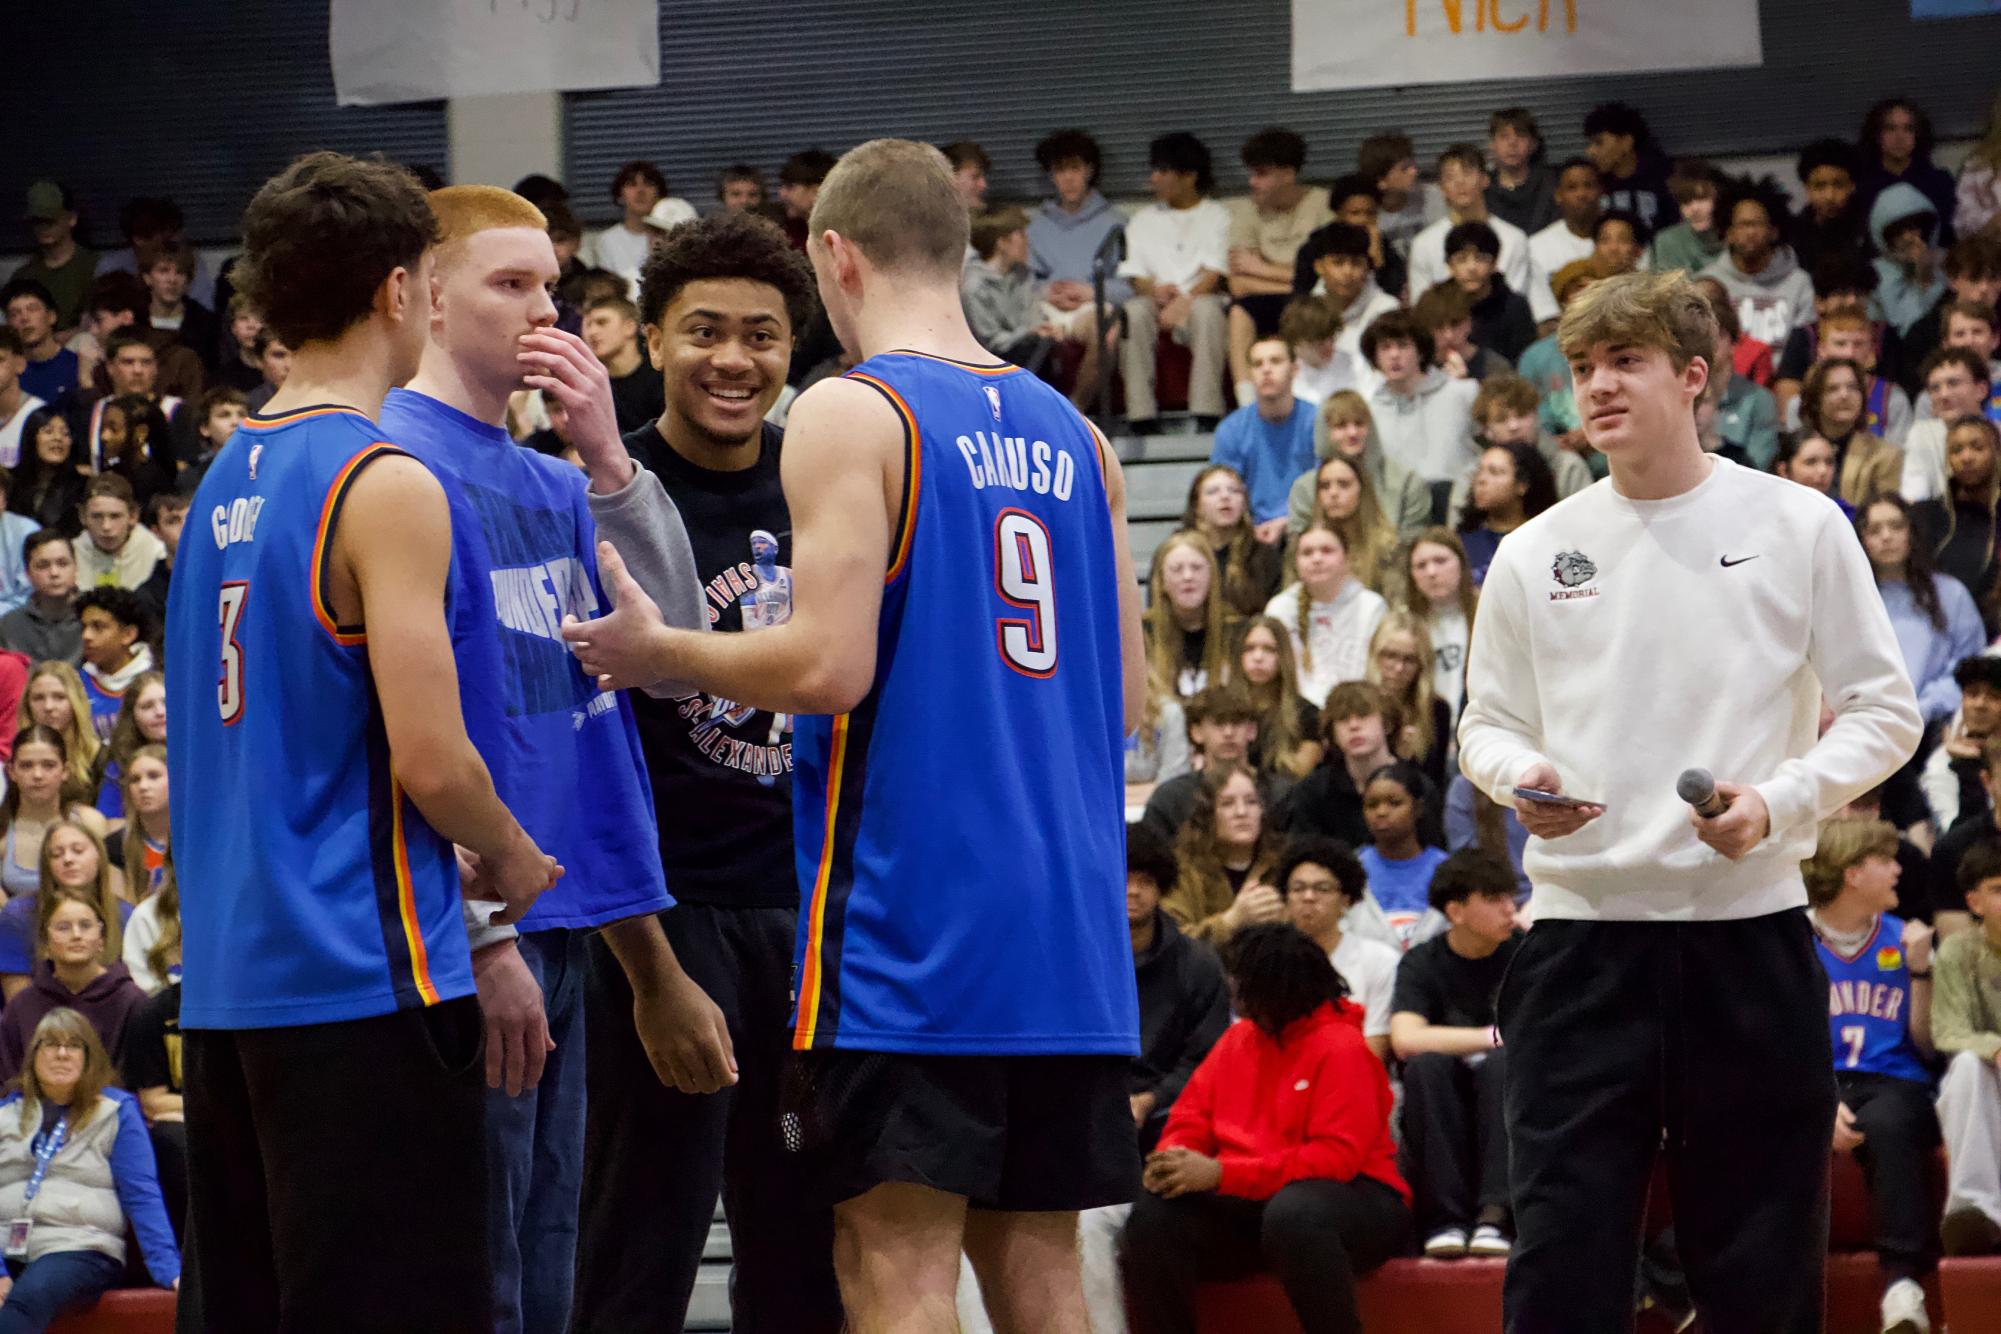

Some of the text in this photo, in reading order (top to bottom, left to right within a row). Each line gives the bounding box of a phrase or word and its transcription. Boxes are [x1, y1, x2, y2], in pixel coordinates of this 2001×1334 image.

[217, 580, 250, 727] 3
[994, 506, 1059, 679] 9
[1840, 1024, 1866, 1068] 7
